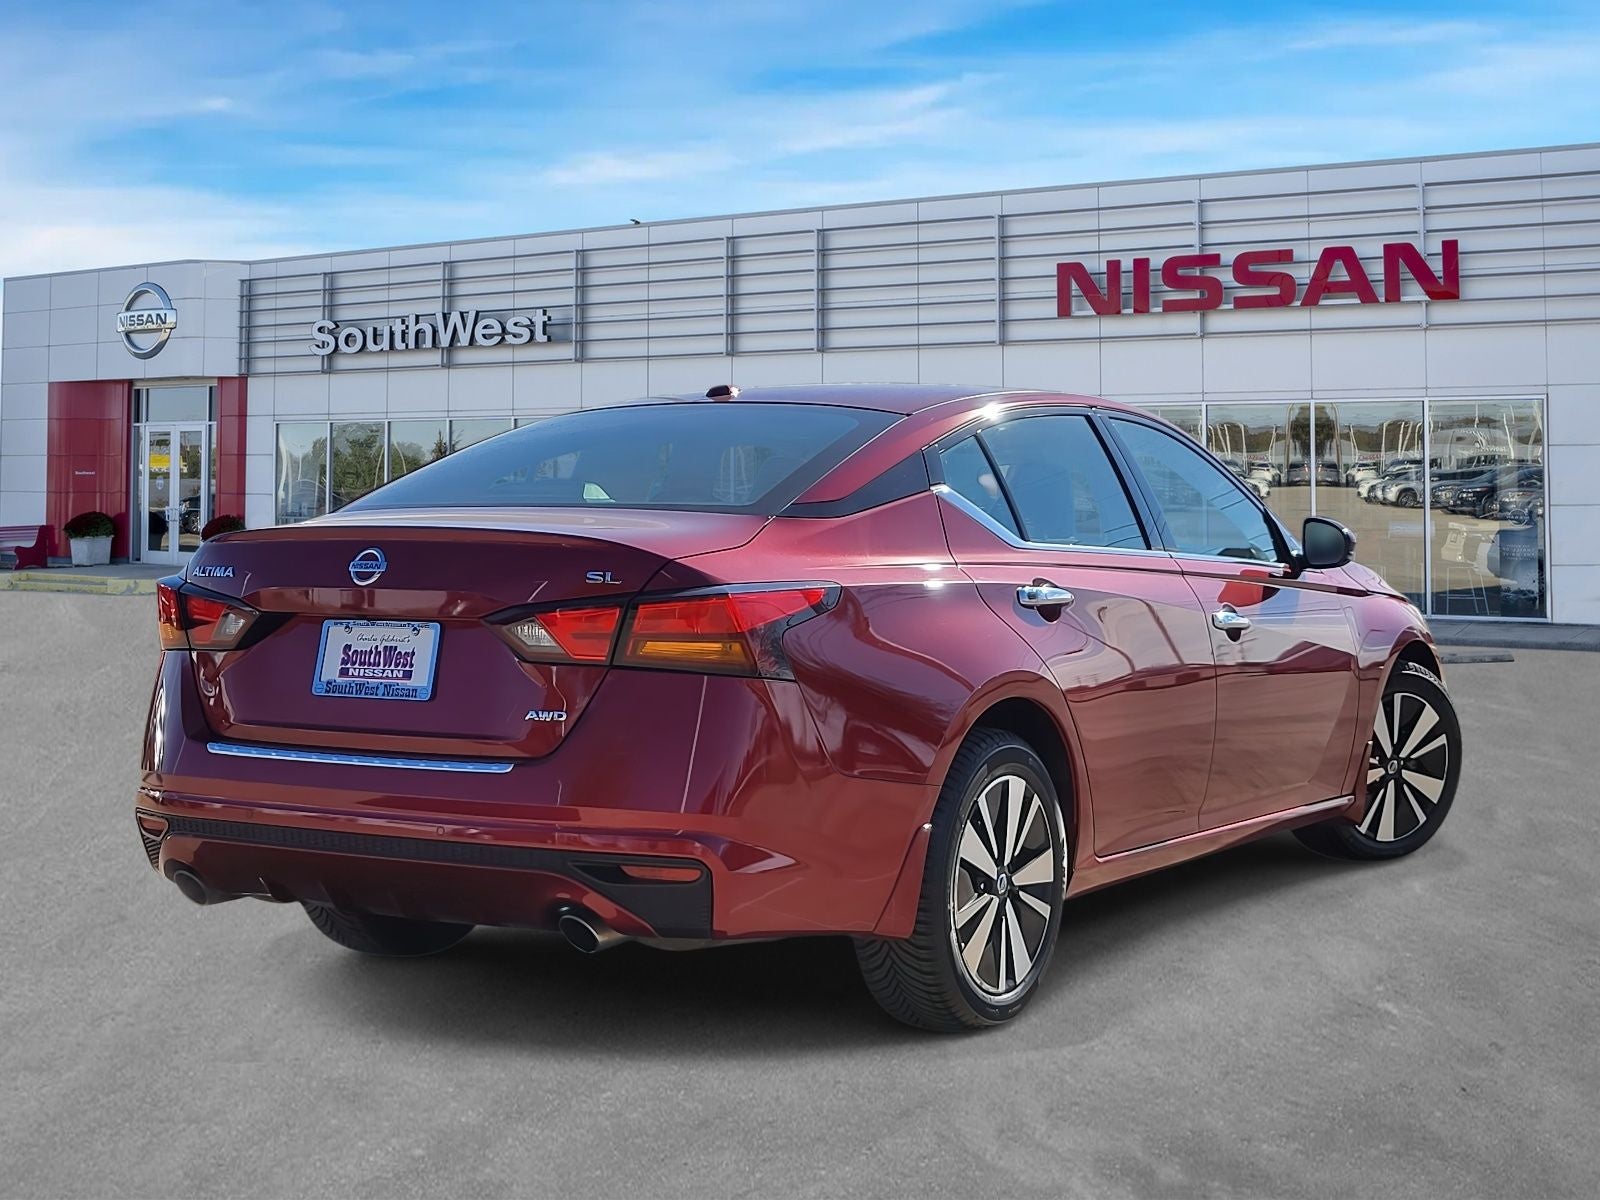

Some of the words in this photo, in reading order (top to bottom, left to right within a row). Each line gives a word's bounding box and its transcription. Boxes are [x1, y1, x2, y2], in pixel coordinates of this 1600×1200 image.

[1057, 239, 1460, 318] NISSAN
[117, 312, 168, 327] NISSAN
[309, 308, 552, 357] SouthWest
[192, 566, 235, 578] ALTIMA
[351, 561, 382, 571] NISSAN
[585, 571, 622, 584] SL
[339, 643, 416, 669] SouthWest
[348, 668, 404, 677] NISSAN
[324, 679, 380, 697] SouthWest
[382, 681, 418, 699] Nissan
[524, 710, 567, 722] AWD
